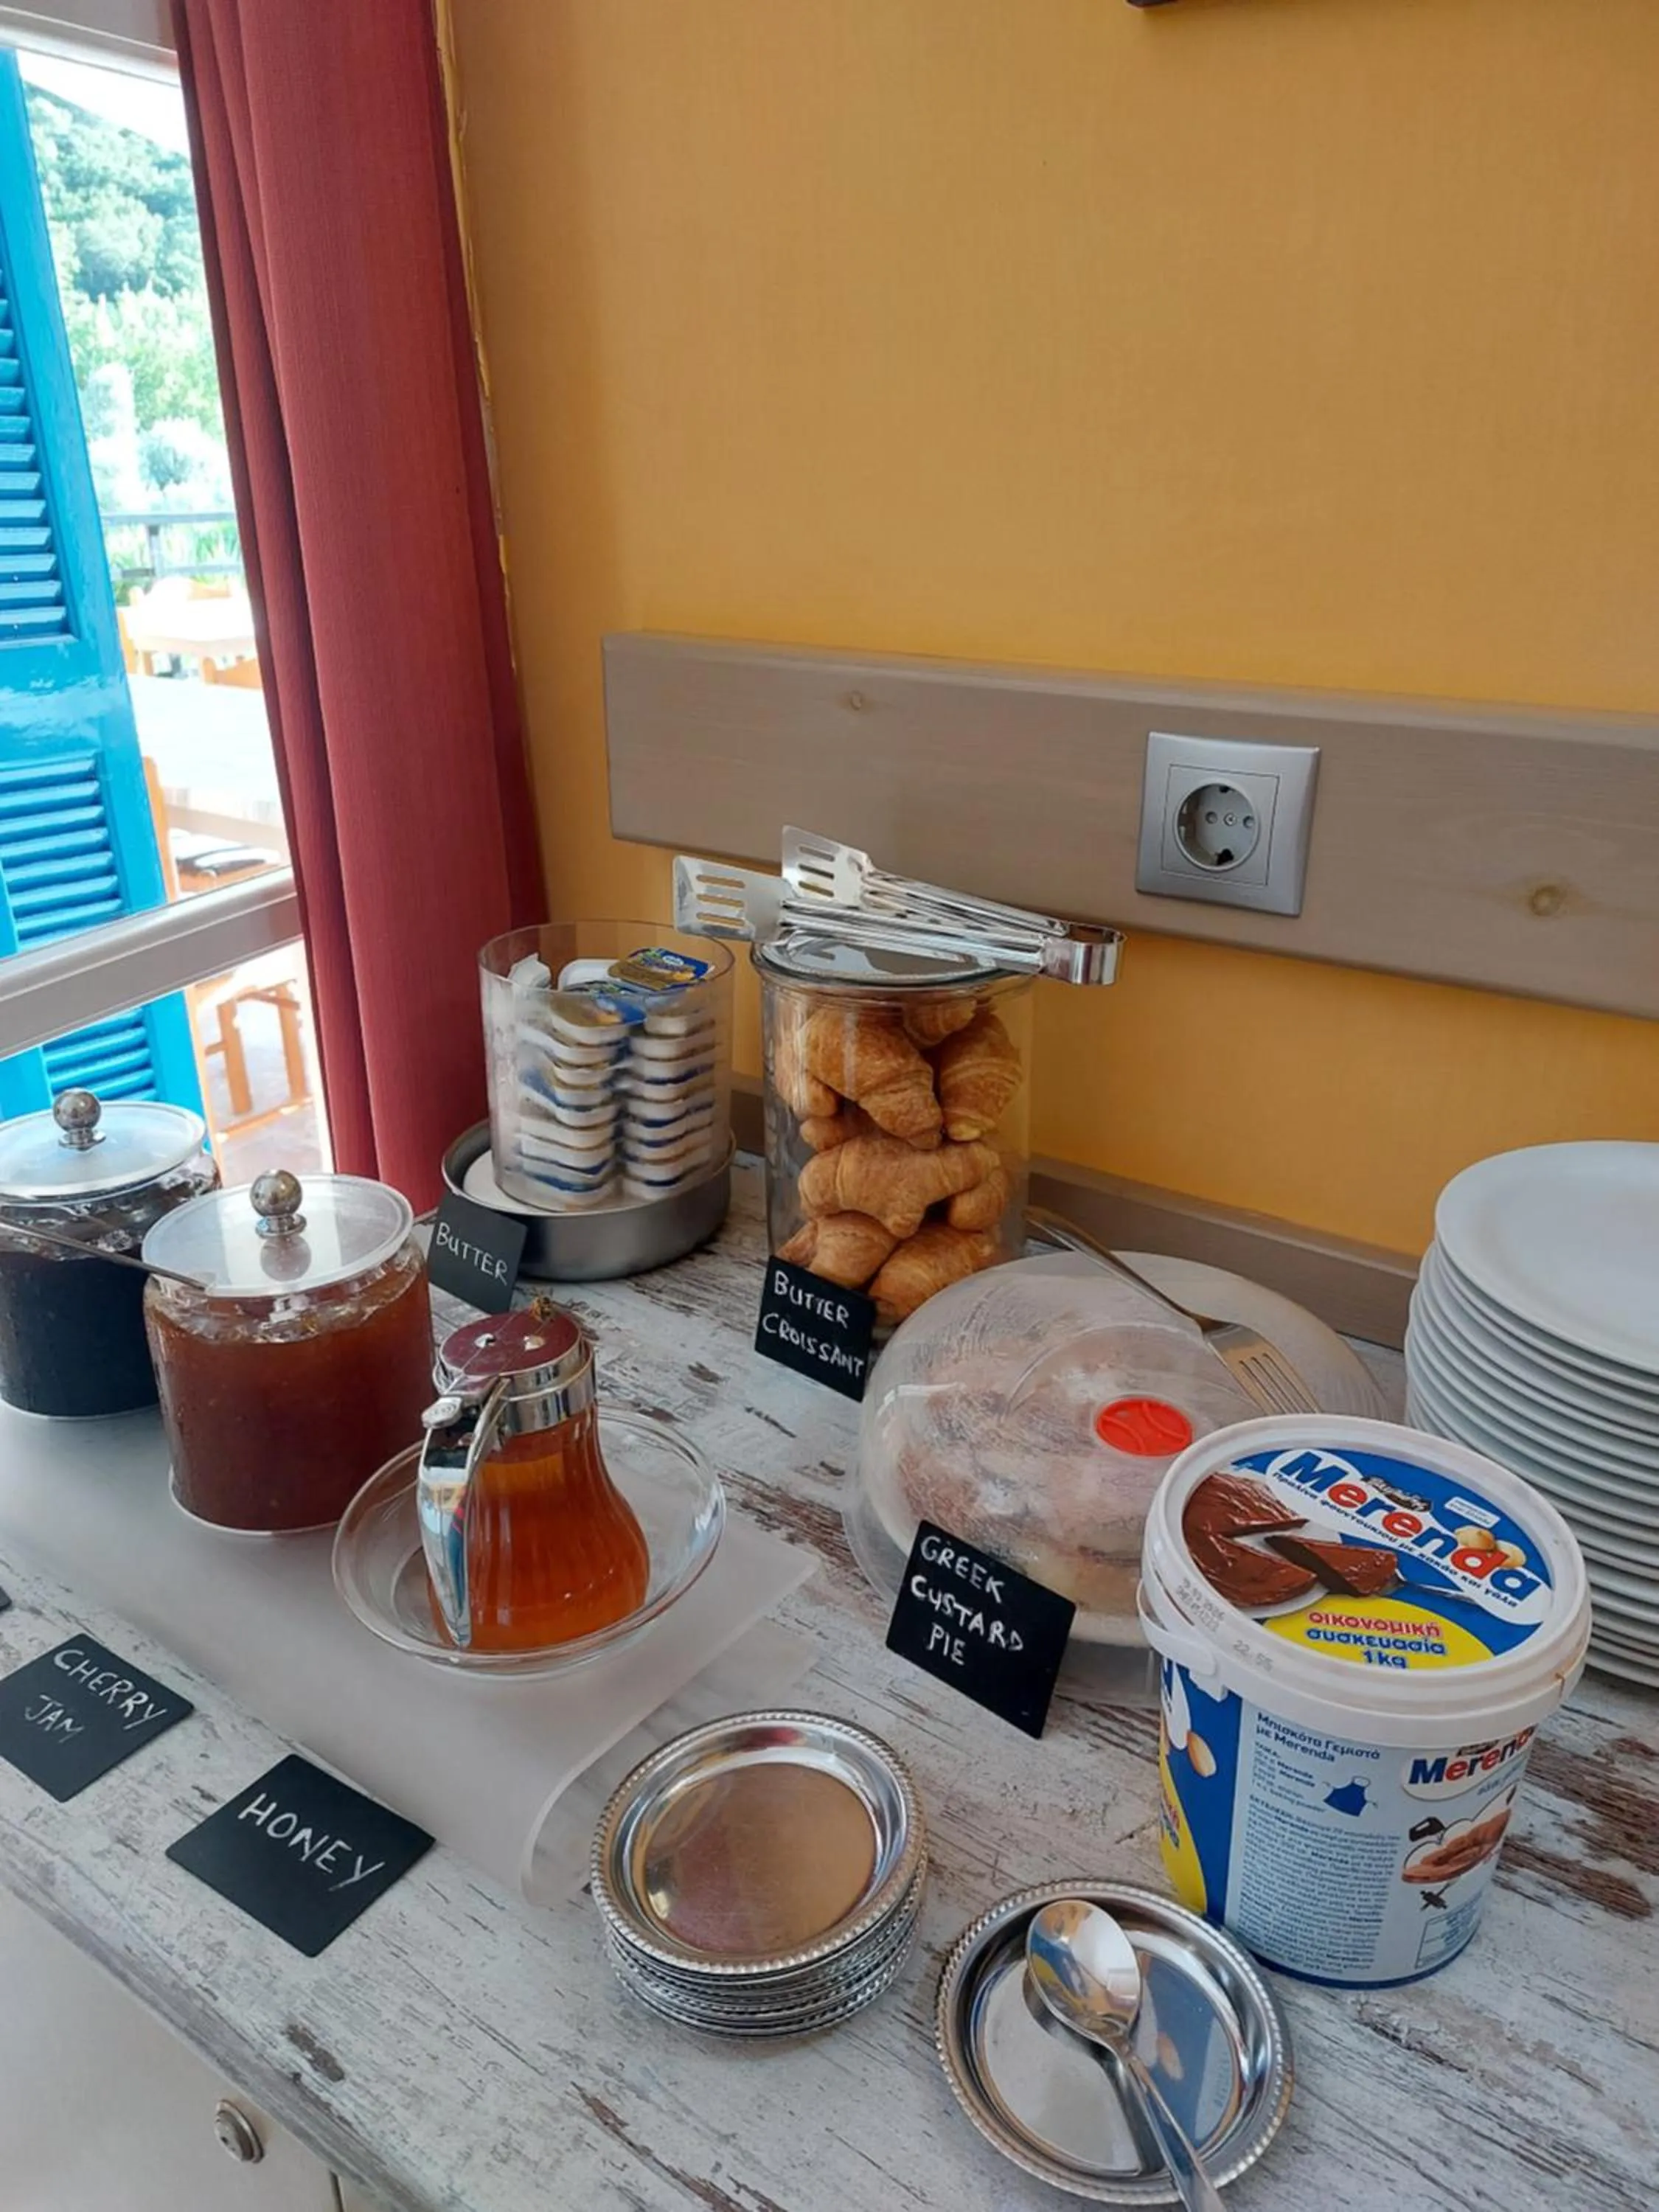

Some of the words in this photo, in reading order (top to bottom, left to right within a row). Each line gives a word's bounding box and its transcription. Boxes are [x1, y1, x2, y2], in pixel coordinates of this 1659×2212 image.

[436, 1221, 508, 1286] BUTTER
[774, 1270, 850, 1329] BUTTER
[762, 1312, 865, 1378] CROISSANT
[1279, 1450, 1542, 1601] Merenda
[919, 1534, 1004, 1604] GREEK
[910, 1575, 1024, 1652] CUSTARD
[1306, 1628, 1447, 1655] συσκευασία
[1308, 1611, 1441, 1638] οικονομική
[926, 1624, 966, 1666] PIE
[1363, 1649, 1374, 1664] 1
[24, 1694, 84, 1744] JAM
[54, 1648, 167, 1730] CHERRY
[1274, 1731, 1336, 1762] Merenda
[237, 1792, 386, 1893] HONEY
